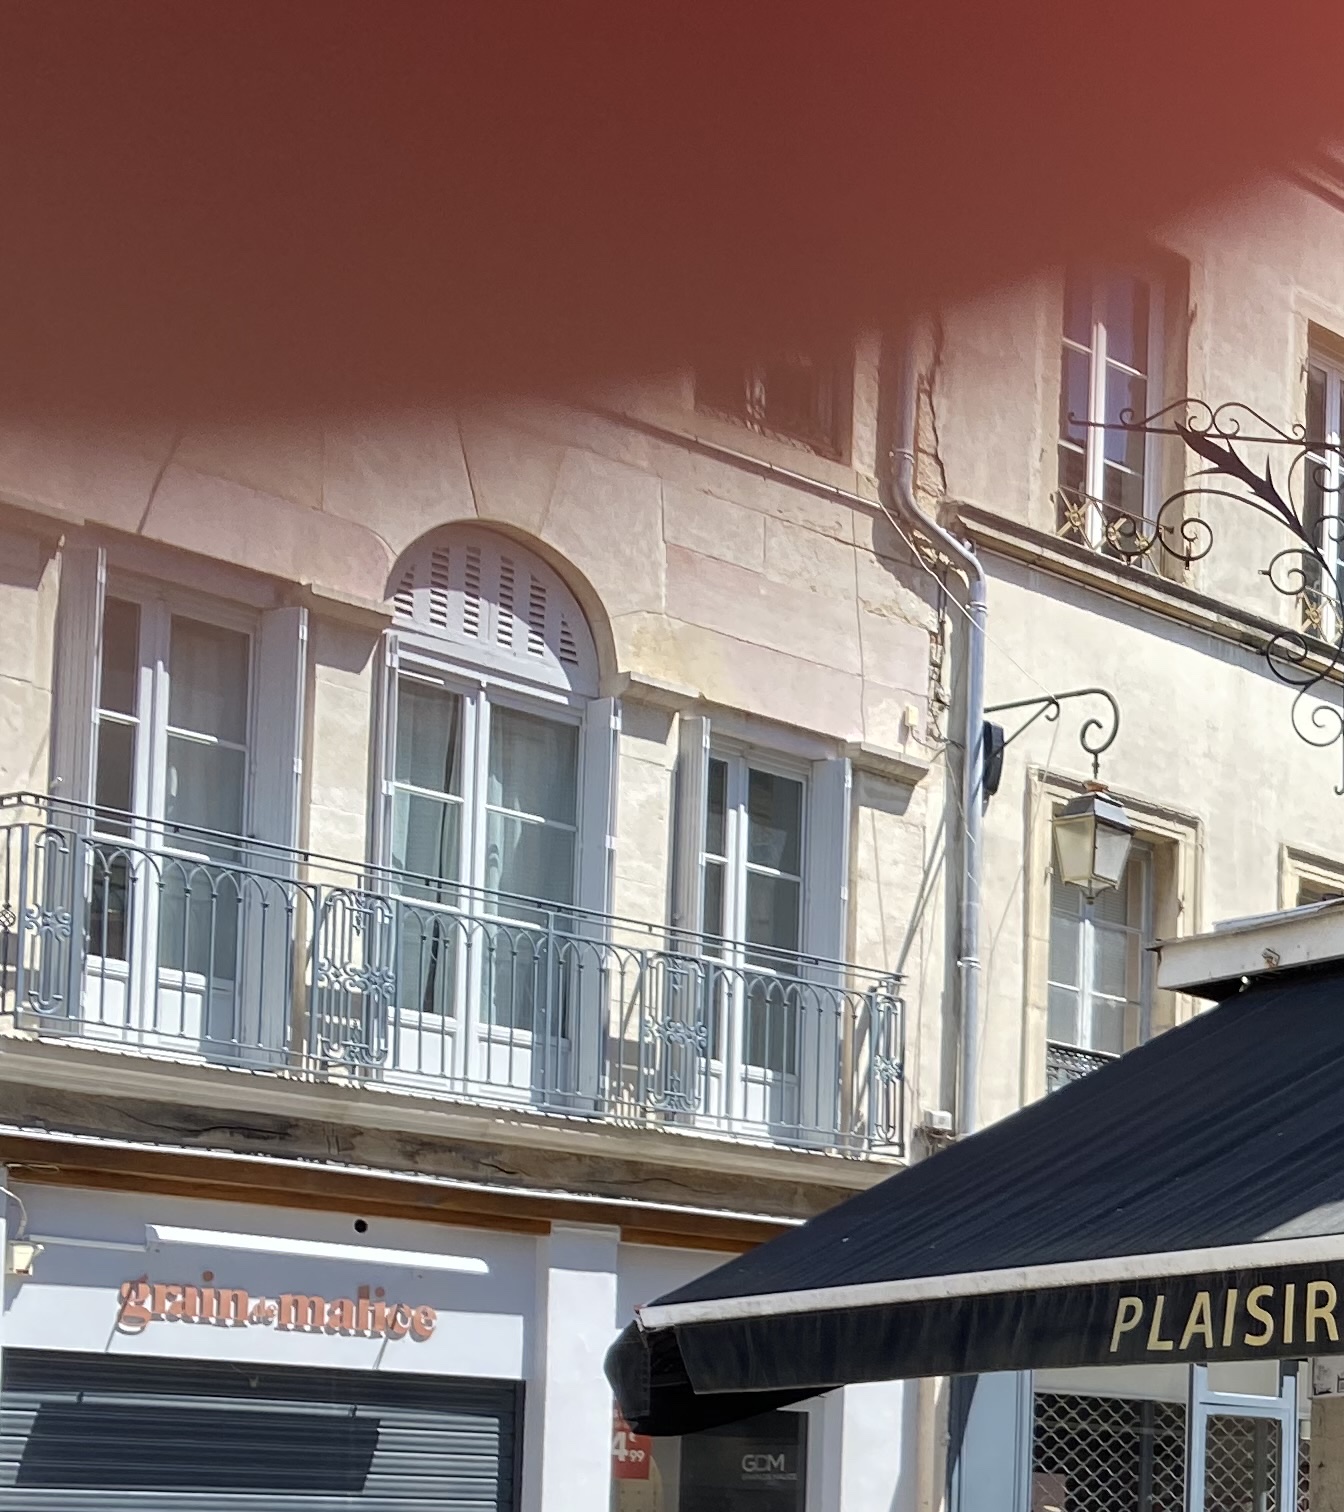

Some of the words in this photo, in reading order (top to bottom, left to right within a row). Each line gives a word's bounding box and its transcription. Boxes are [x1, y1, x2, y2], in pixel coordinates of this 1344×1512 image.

[118, 1270, 249, 1328] grain
[252, 1296, 278, 1321] de
[278, 1284, 438, 1335] malice
[741, 1453, 785, 1472] GDM
